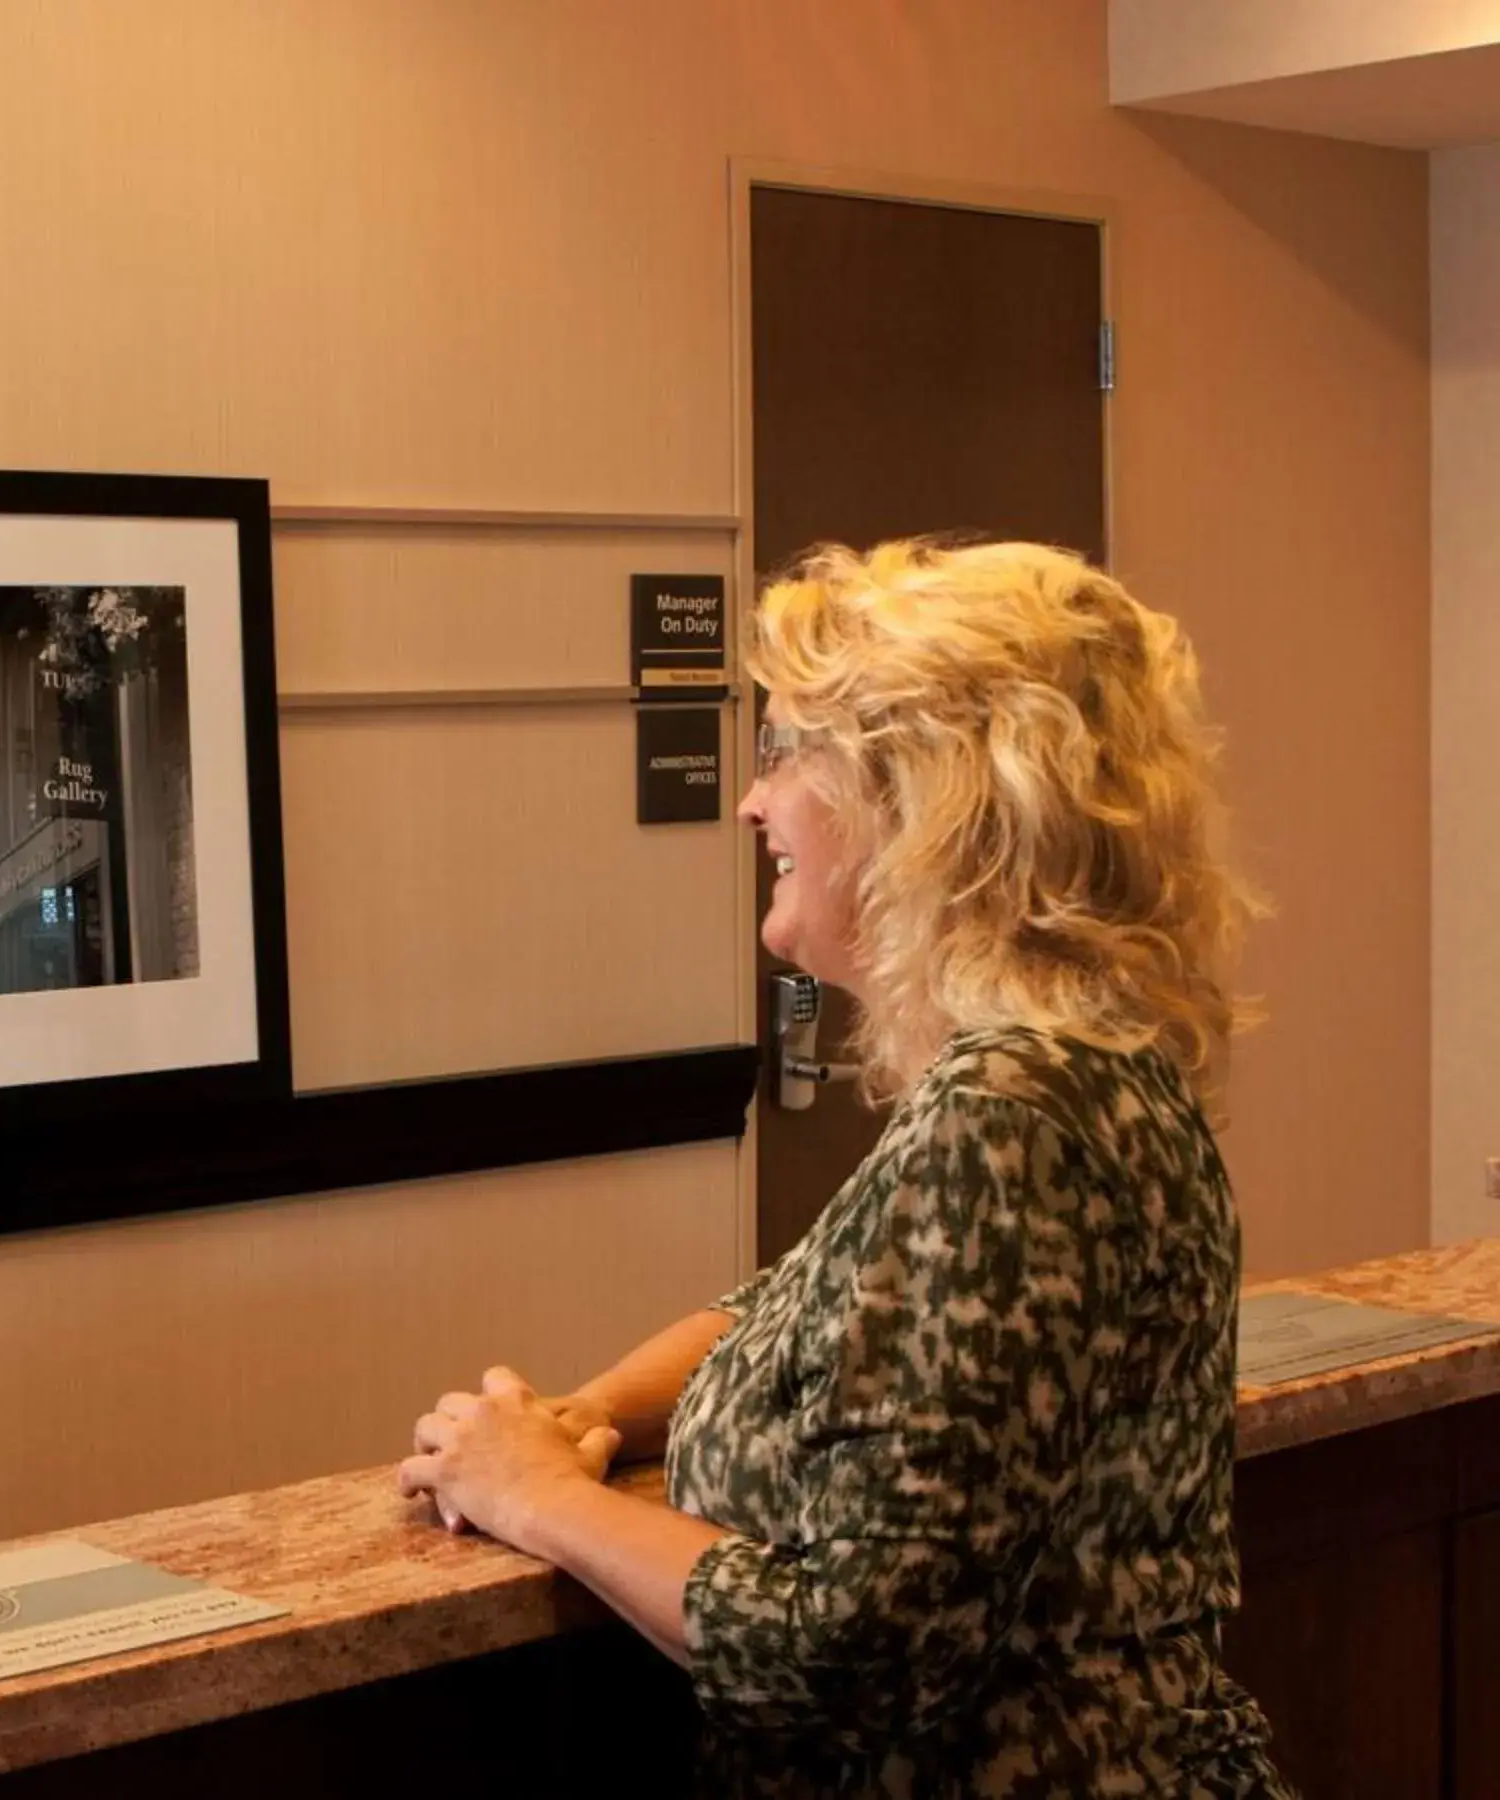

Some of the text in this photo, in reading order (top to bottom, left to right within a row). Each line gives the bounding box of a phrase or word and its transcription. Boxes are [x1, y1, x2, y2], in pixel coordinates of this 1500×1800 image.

[657, 592, 718, 614] Manager
[661, 616, 718, 637] On Duty
[58, 755, 93, 783] Rug
[43, 779, 109, 811] Gallery
